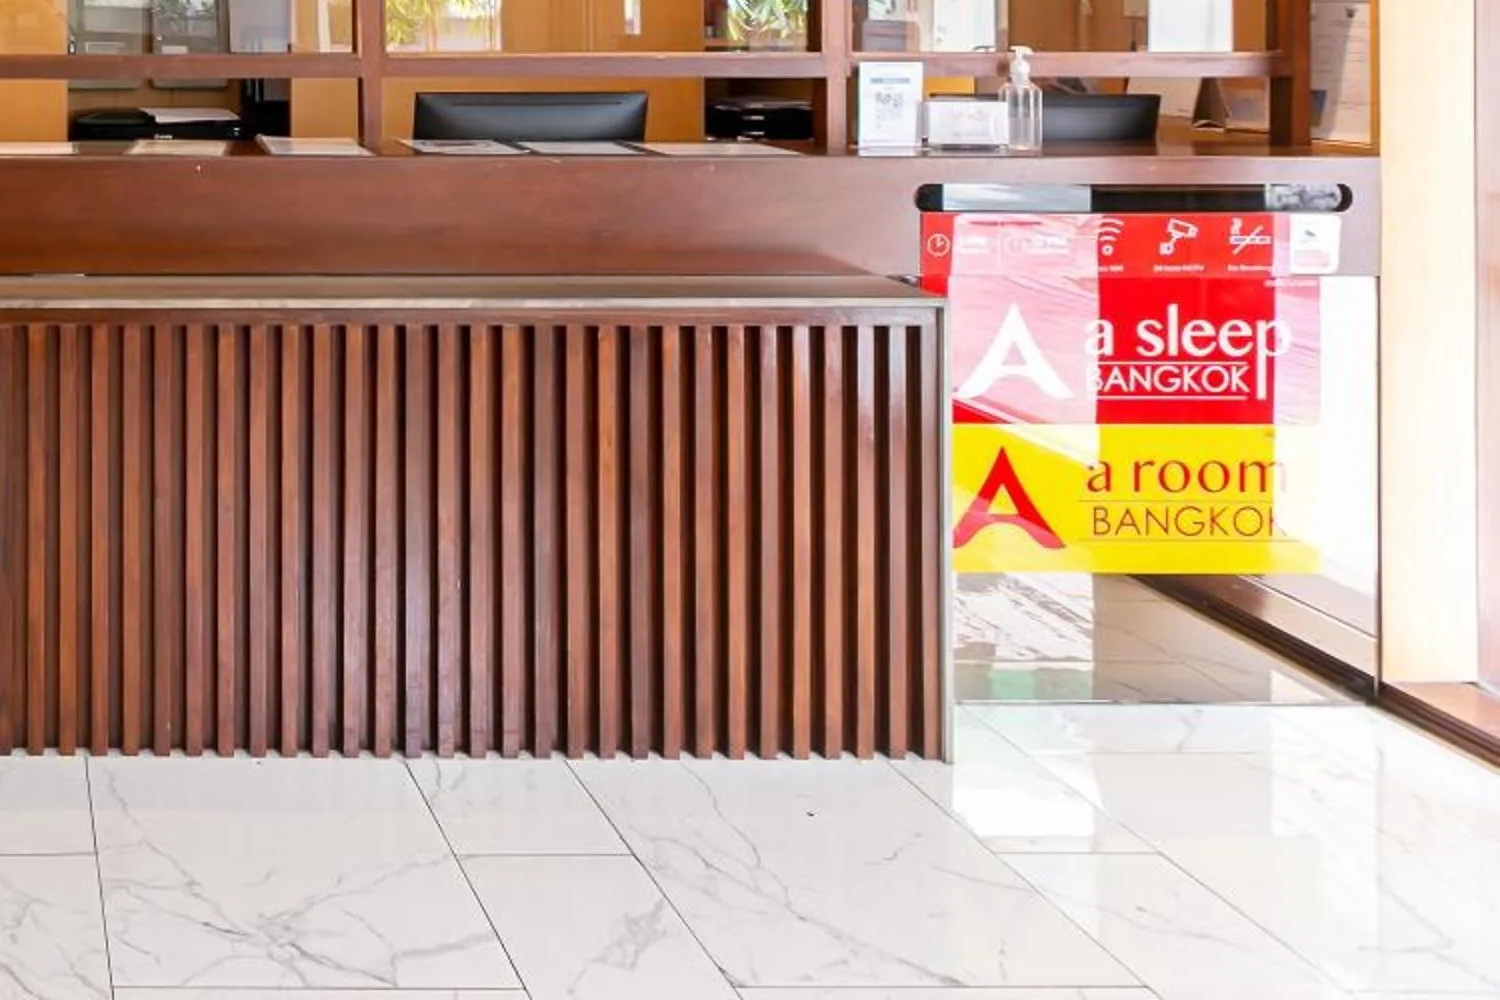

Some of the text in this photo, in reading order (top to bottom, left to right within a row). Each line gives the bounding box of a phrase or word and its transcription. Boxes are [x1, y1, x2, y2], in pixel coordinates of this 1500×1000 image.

[1085, 304, 1291, 400] a sleep
[1087, 365, 1249, 393] BANGKOK
[1087, 460, 1286, 493] a room
